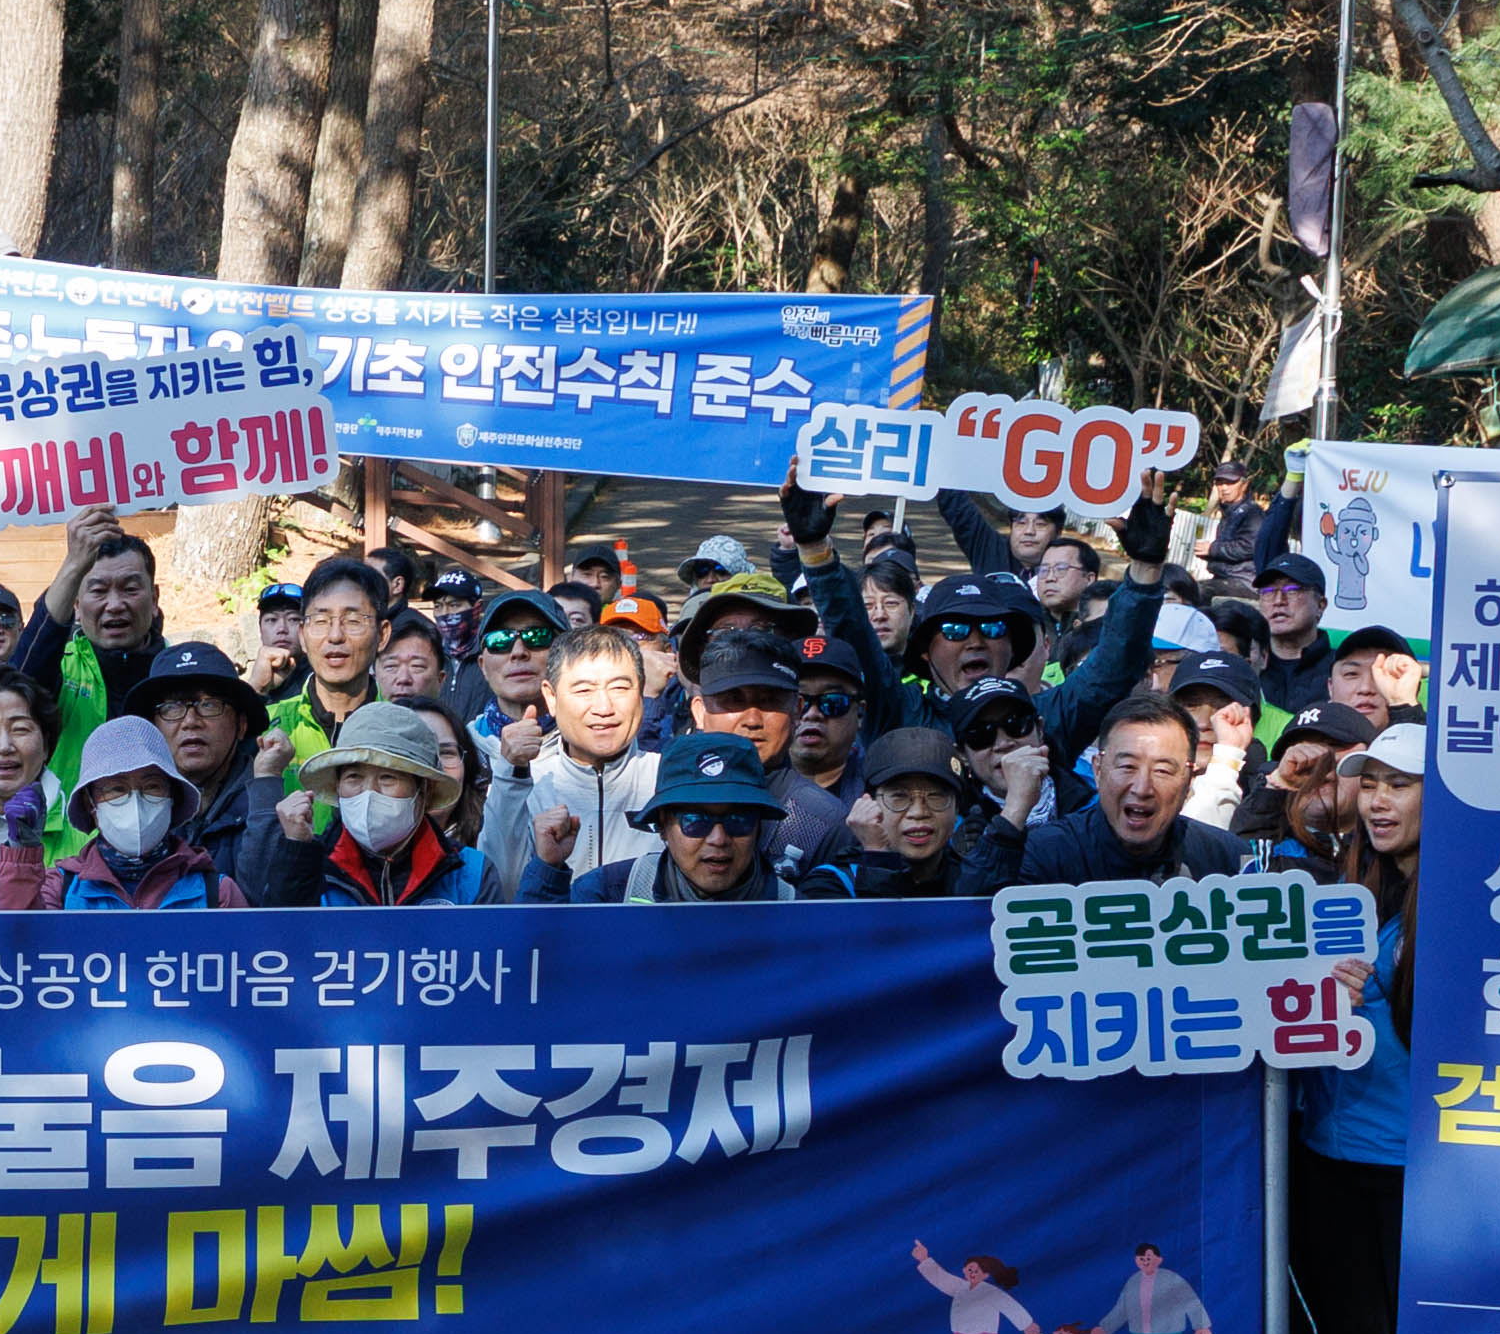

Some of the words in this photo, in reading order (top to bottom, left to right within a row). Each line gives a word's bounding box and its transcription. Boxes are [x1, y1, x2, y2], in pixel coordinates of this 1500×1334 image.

[405, 298, 484, 329] 지키는
[489, 304, 543, 332] 작은
[550, 306, 699, 336] 실천입니다!!
[147, 357, 245, 399] 지키는
[253, 335, 314, 388] 힘,
[317, 335, 427, 394] 기초
[440, 343, 676, 415] 안전수칙
[691, 352, 813, 423] 준수
[170, 406, 330, 496] 함께!
[810, 416, 933, 487] 살리
[957, 405, 1187, 505] “GO”
[1339, 468, 1389, 493] JEJU
[1006, 883, 1366, 975] 골목상권을
[146, 947, 294, 1007] 한마음
[311, 946, 510, 1007] 걷기행사
[1015, 985, 1242, 1067] 지키는
[1266, 977, 1362, 1057] 힘,
[269, 1034, 812, 1182] 제주경제
[164, 1203, 475, 1327] 마씸!
